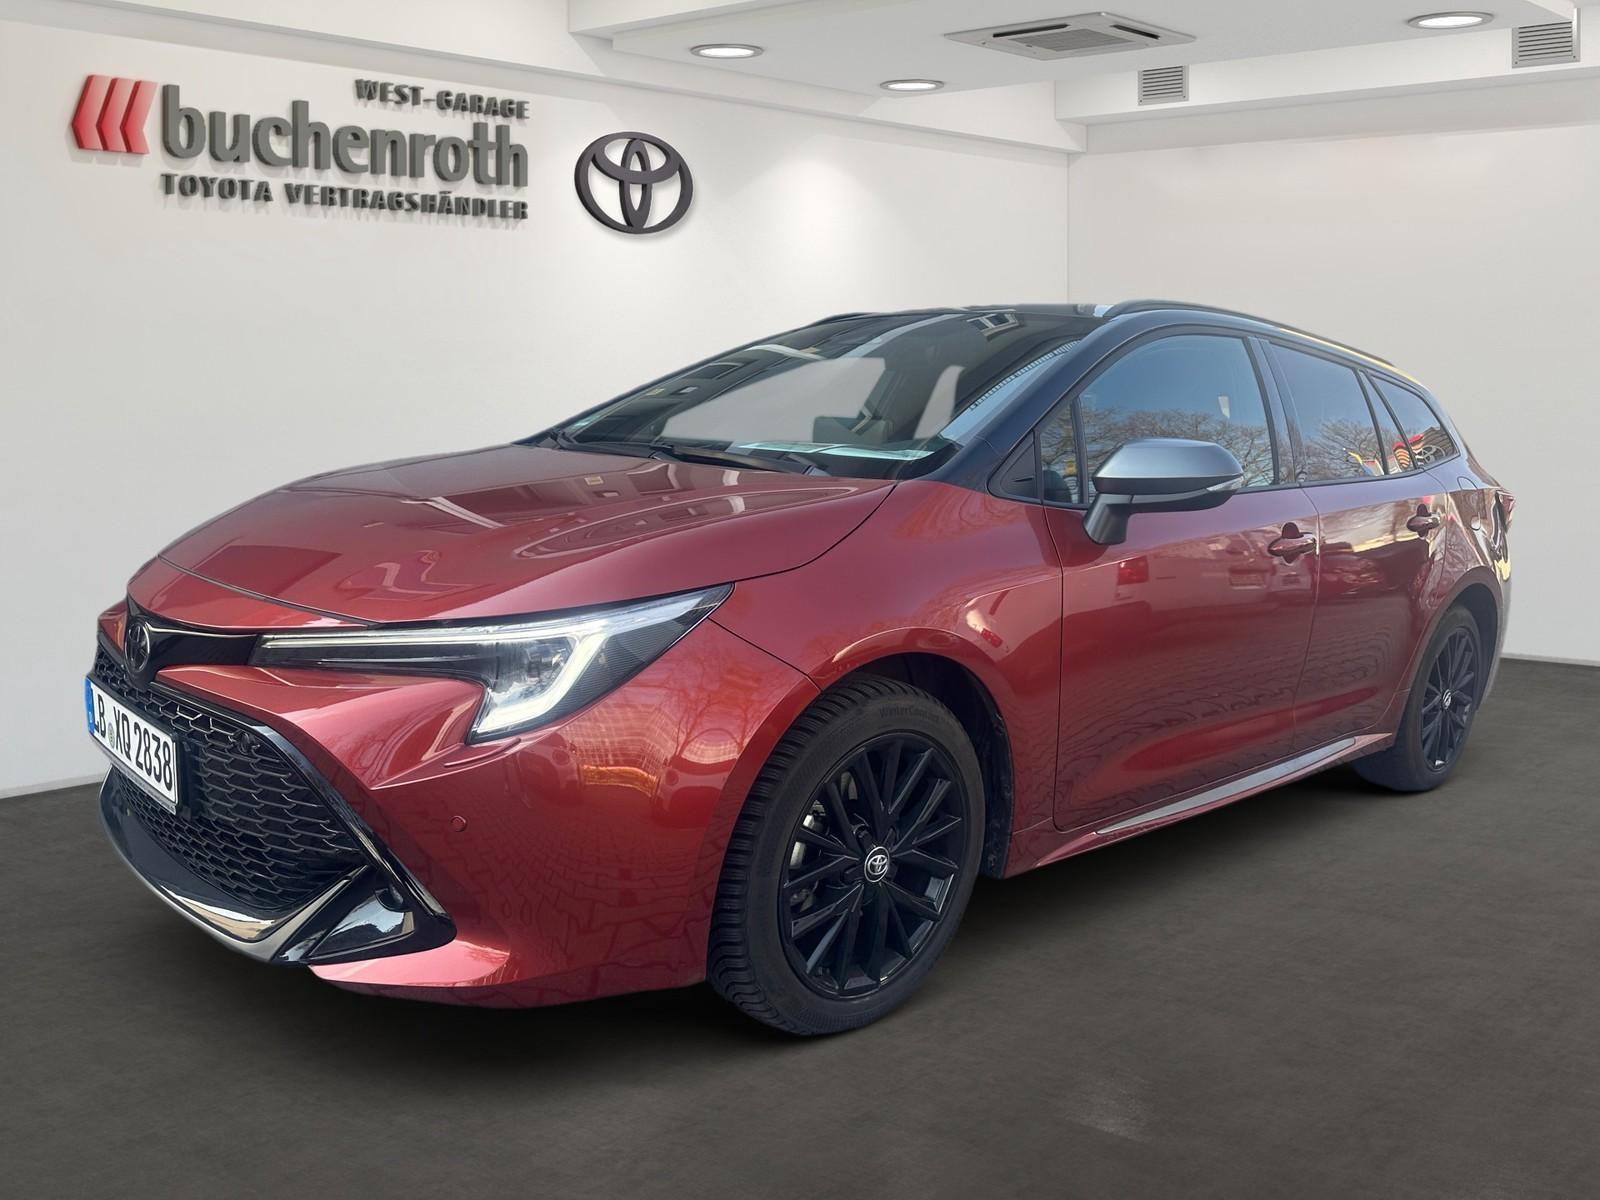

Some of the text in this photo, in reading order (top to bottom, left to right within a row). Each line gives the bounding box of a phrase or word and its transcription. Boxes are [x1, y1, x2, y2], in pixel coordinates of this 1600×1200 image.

[355, 79, 530, 119] WEST-GARAGE
[162, 84, 528, 187] buchenroth
[161, 173, 528, 219] TOYOTA VERTRAGSHÄNDLER
[113, 705, 131, 762] XQ
[134, 721, 172, 791] 2838
